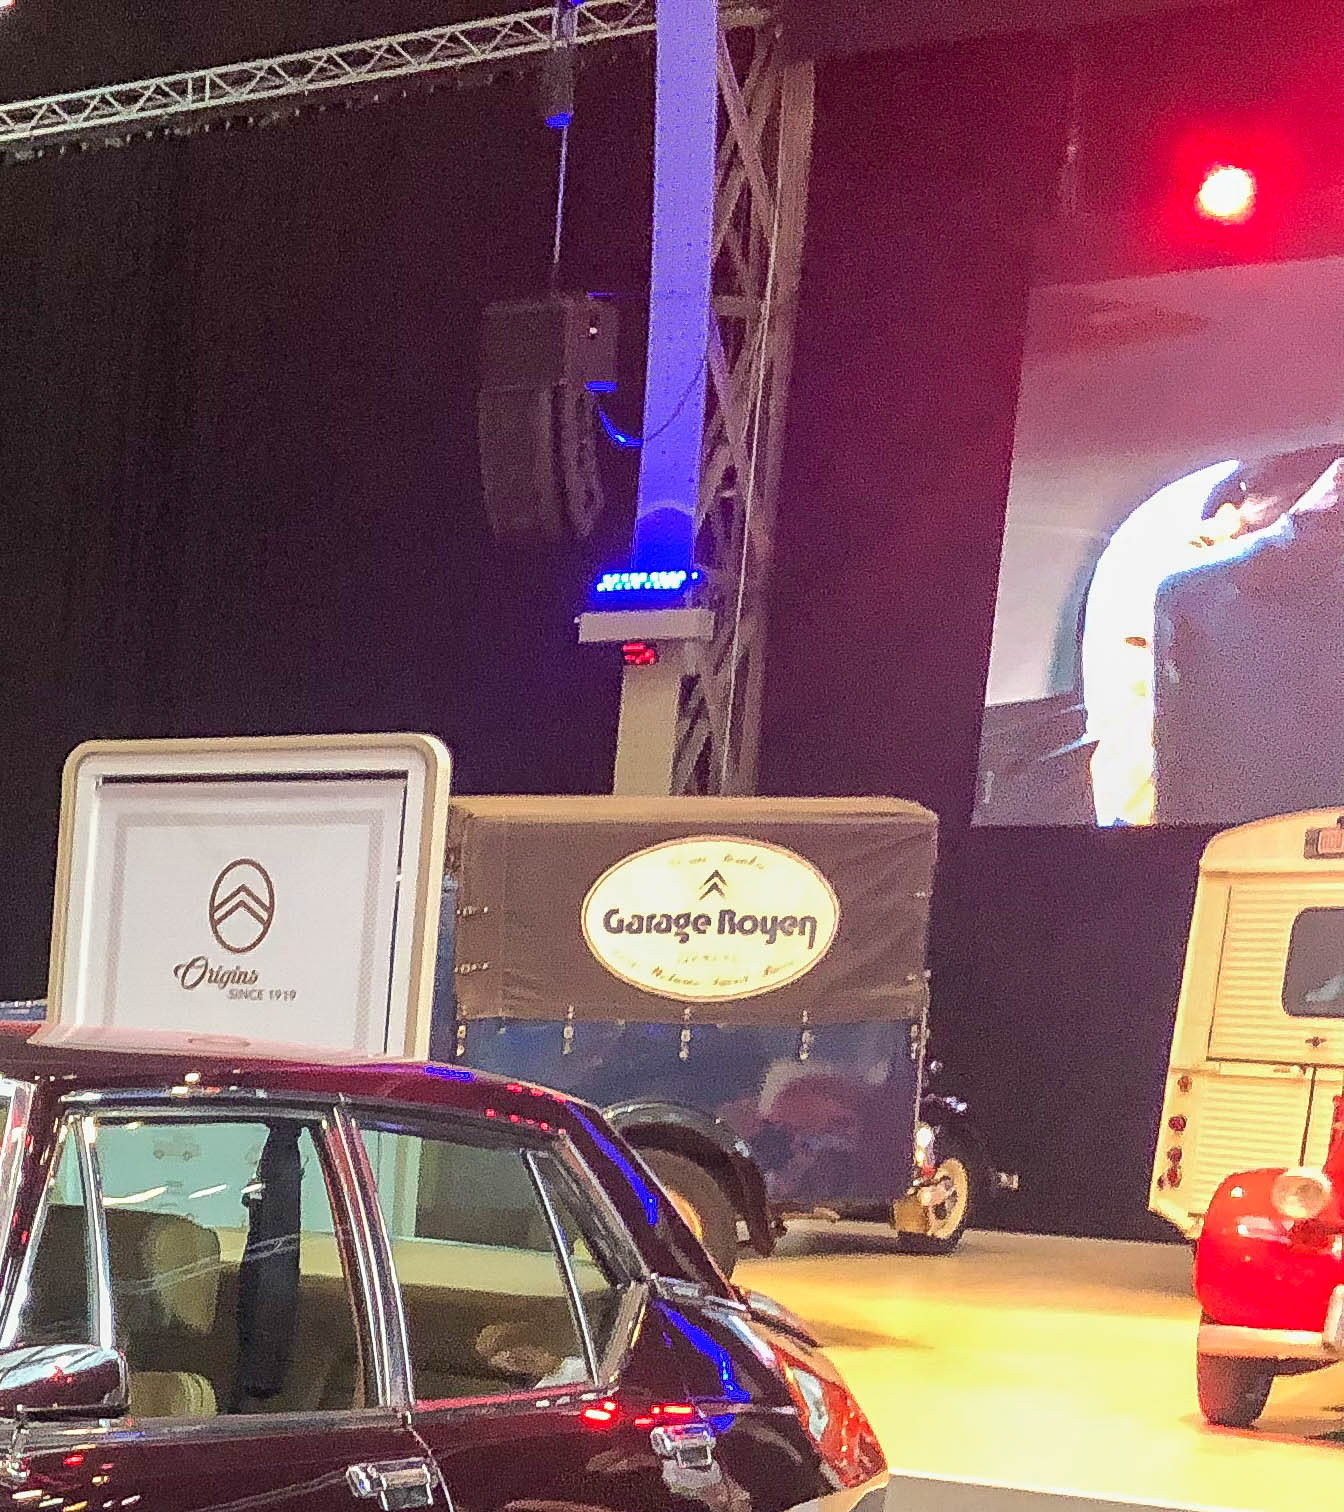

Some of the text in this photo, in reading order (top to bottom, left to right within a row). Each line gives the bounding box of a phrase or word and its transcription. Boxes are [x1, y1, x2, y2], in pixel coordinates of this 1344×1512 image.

[603, 908, 817, 950] Garage Royen
[173, 955, 259, 990] Origins
[227, 988, 297, 1002] SINCE 1919
